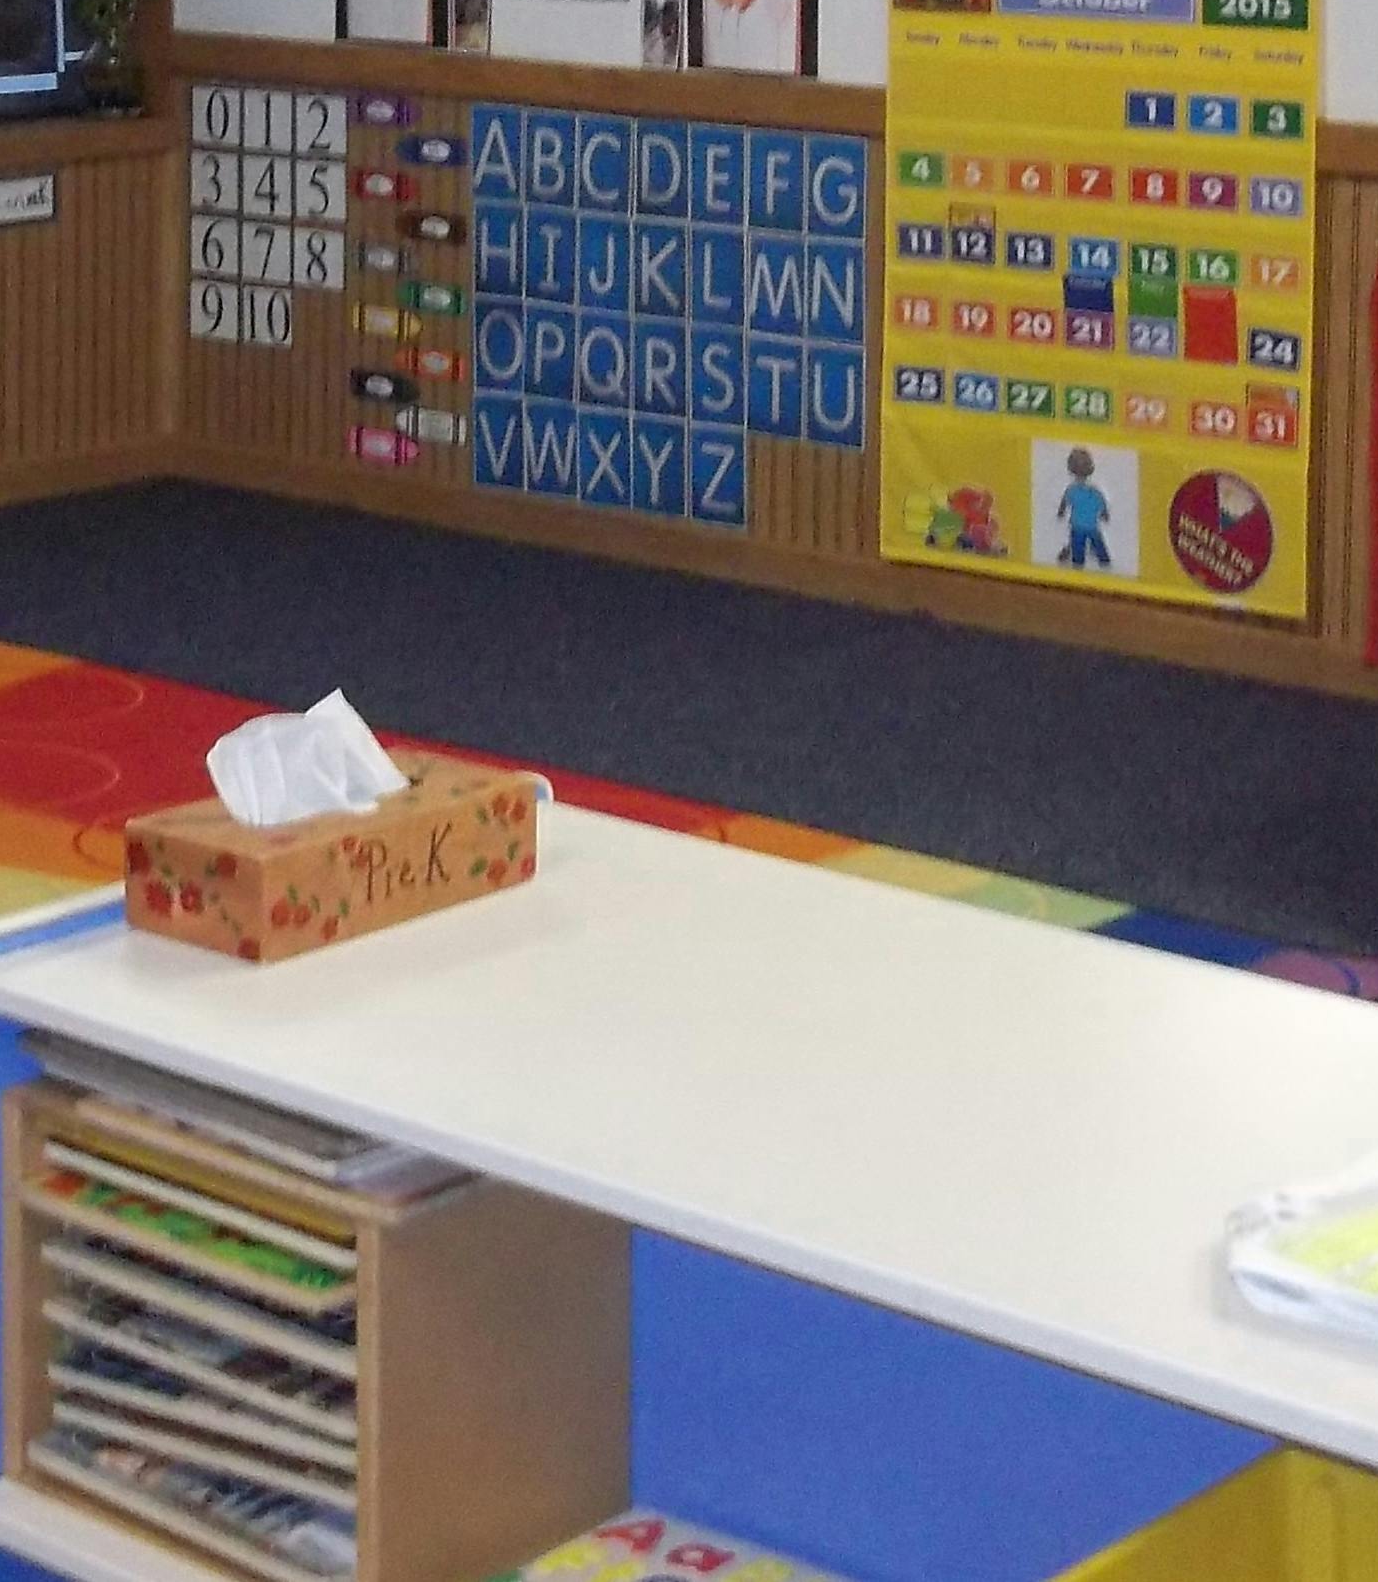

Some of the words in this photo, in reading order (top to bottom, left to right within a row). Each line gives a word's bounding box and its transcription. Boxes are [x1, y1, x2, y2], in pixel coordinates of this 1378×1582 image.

[206, 89, 230, 140] 0
[264, 92, 271, 146] 1
[307, 98, 331, 150] 2
[1145, 97, 1158, 123] 1
[1204, 101, 1224, 128] 2
[1268, 106, 1287, 132] 3
[202, 153, 222, 204] 3
[254, 158, 280, 212] 4
[308, 167, 329, 216] 5
[473, 117, 517, 194] A
[532, 126, 566, 197] B
[581, 132, 622, 201] C
[640, 133, 683, 205] D
[706, 143, 731, 214] E
[766, 150, 792, 216] F
[813, 156, 858, 224] G
[912, 156, 931, 179] 4
[965, 161, 982, 187] 5
[1022, 166, 1040, 191] 6
[1082, 168, 1102, 193] 7
[1146, 173, 1165, 199] 8
[1203, 176, 1222, 202] 9
[1258, 183, 1294, 209] 10
[201, 220, 224, 270] 6
[254, 226, 275, 280] 7
[307, 230, 328, 283] 8
[479, 221, 518, 284] H
[539, 225, 562, 293] I
[588, 232, 615, 295] J
[641, 235, 681, 309] K
[703, 241, 732, 307] L
[751, 251, 803, 319] M
[811, 254, 855, 328] N
[909, 228, 933, 253] 11
[957, 231, 988, 257] 12
[1014, 236, 1044, 263] 13
[1079, 243, 1111, 269] 14
[1138, 246, 1169, 273] 15
[1197, 254, 1230, 281] 16
[1257, 258, 1291, 285] 17
[201, 283, 224, 333] 9
[249, 289, 291, 342] 10
[901, 298, 931, 324] 18
[960, 305, 989, 330] 19
[1013, 311, 1052, 338] 20
[1072, 317, 1103, 344] 21
[1130, 324, 1171, 350] 22
[1254, 336, 1294, 365] 24
[478, 308, 524, 381] O
[533, 320, 566, 386] P
[580, 325, 625, 397] Q
[644, 337, 677, 408] R
[702, 342, 735, 413] S
[755, 355, 797, 424] T
[813, 362, 856, 432] U
[900, 370, 939, 397] 25
[958, 376, 994, 403] 26
[1011, 384, 1048, 410] 27
[1070, 390, 1108, 416] 28
[1130, 395, 1166, 421] 29
[1197, 405, 1235, 433] 30
[1254, 411, 1286, 440] 31
[478, 410, 517, 481] V
[523, 413, 577, 485] W
[585, 428, 626, 498] X
[638, 432, 675, 506] Y
[700, 441, 738, 515] Z
